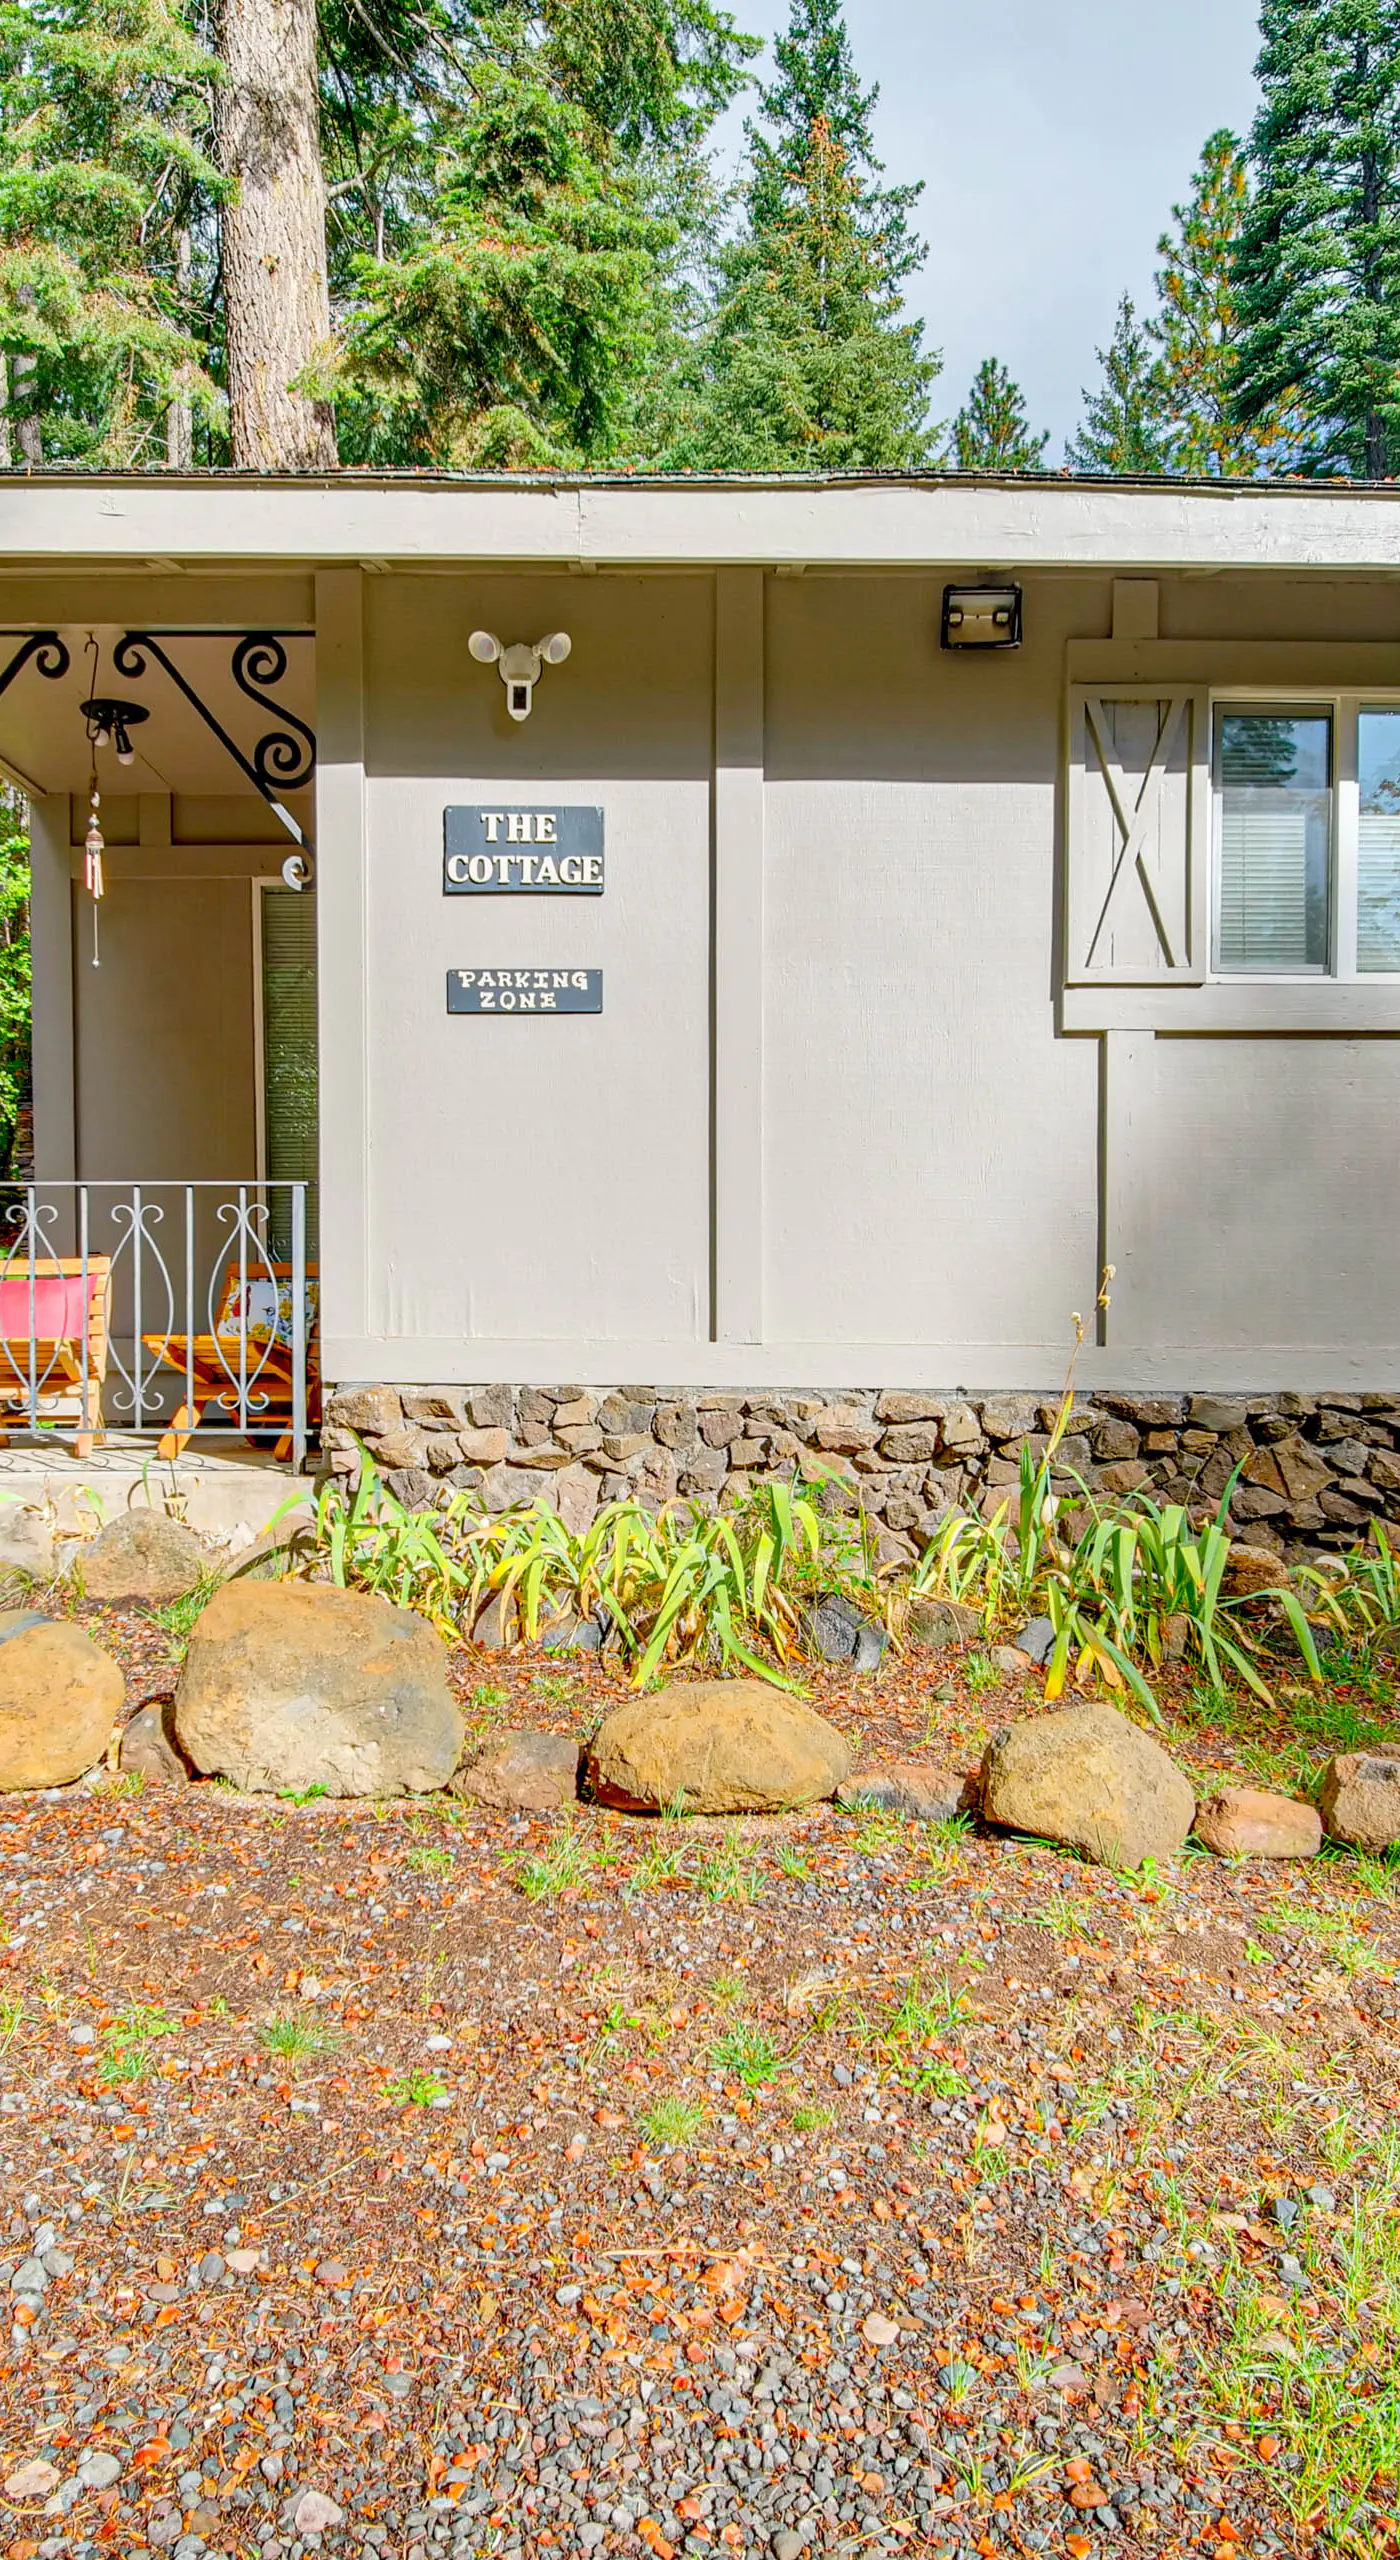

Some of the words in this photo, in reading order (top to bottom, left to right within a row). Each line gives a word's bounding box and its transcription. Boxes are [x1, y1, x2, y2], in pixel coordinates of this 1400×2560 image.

[481, 813, 557, 842] THE
[447, 855, 603, 884] COTTAGE
[458, 971, 588, 990] PARKING
[480, 991, 556, 1009] ZONE
